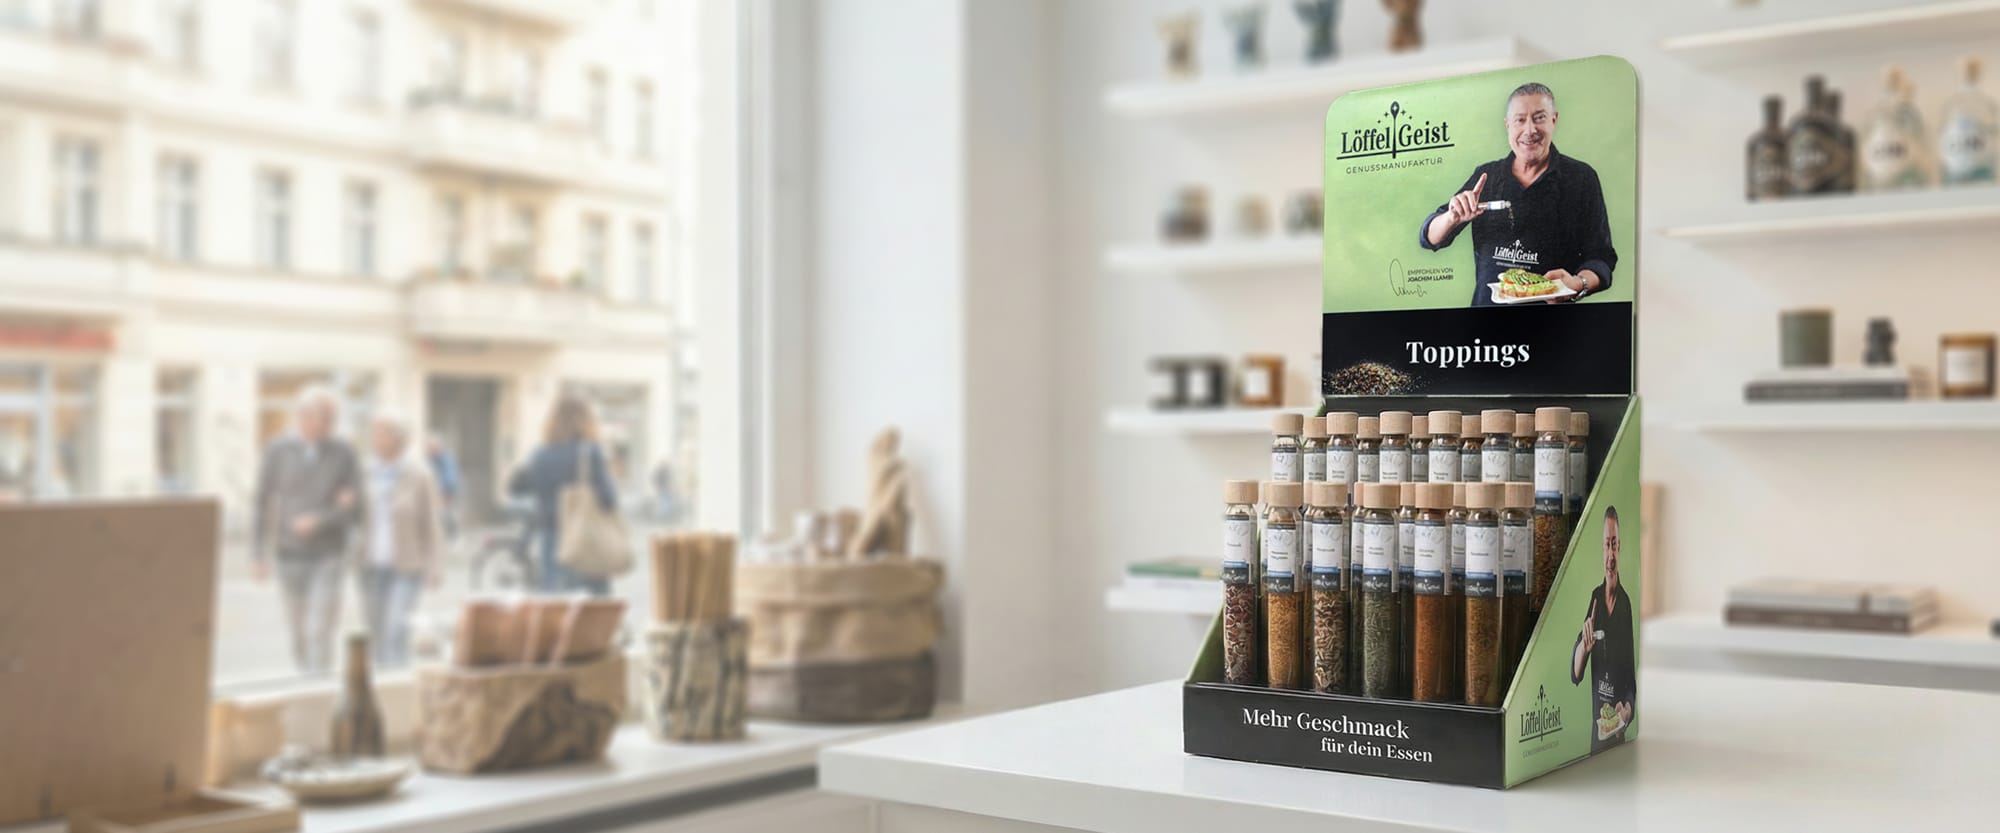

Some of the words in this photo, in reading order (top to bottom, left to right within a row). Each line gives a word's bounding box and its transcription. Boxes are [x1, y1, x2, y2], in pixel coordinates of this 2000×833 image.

[1341, 127, 1391, 154] Löffel
[1398, 121, 1450, 147] Geist
[1345, 157, 1444, 174] GENUSSMANUFAKTUR
[1407, 268, 1440, 276] EMPFOHLEN
[1407, 275, 1433, 283] JOACHIM
[1406, 338, 1530, 368] Toppings
[1242, 707, 1292, 729] Mehr
[1296, 711, 1411, 739] Geschmack
[1520, 711, 1541, 737] Löffel
[1542, 706, 1561, 730] Geist
[1320, 737, 1345, 753] für
[1348, 740, 1382, 758] dein
[1386, 744, 1433, 763] Essen
